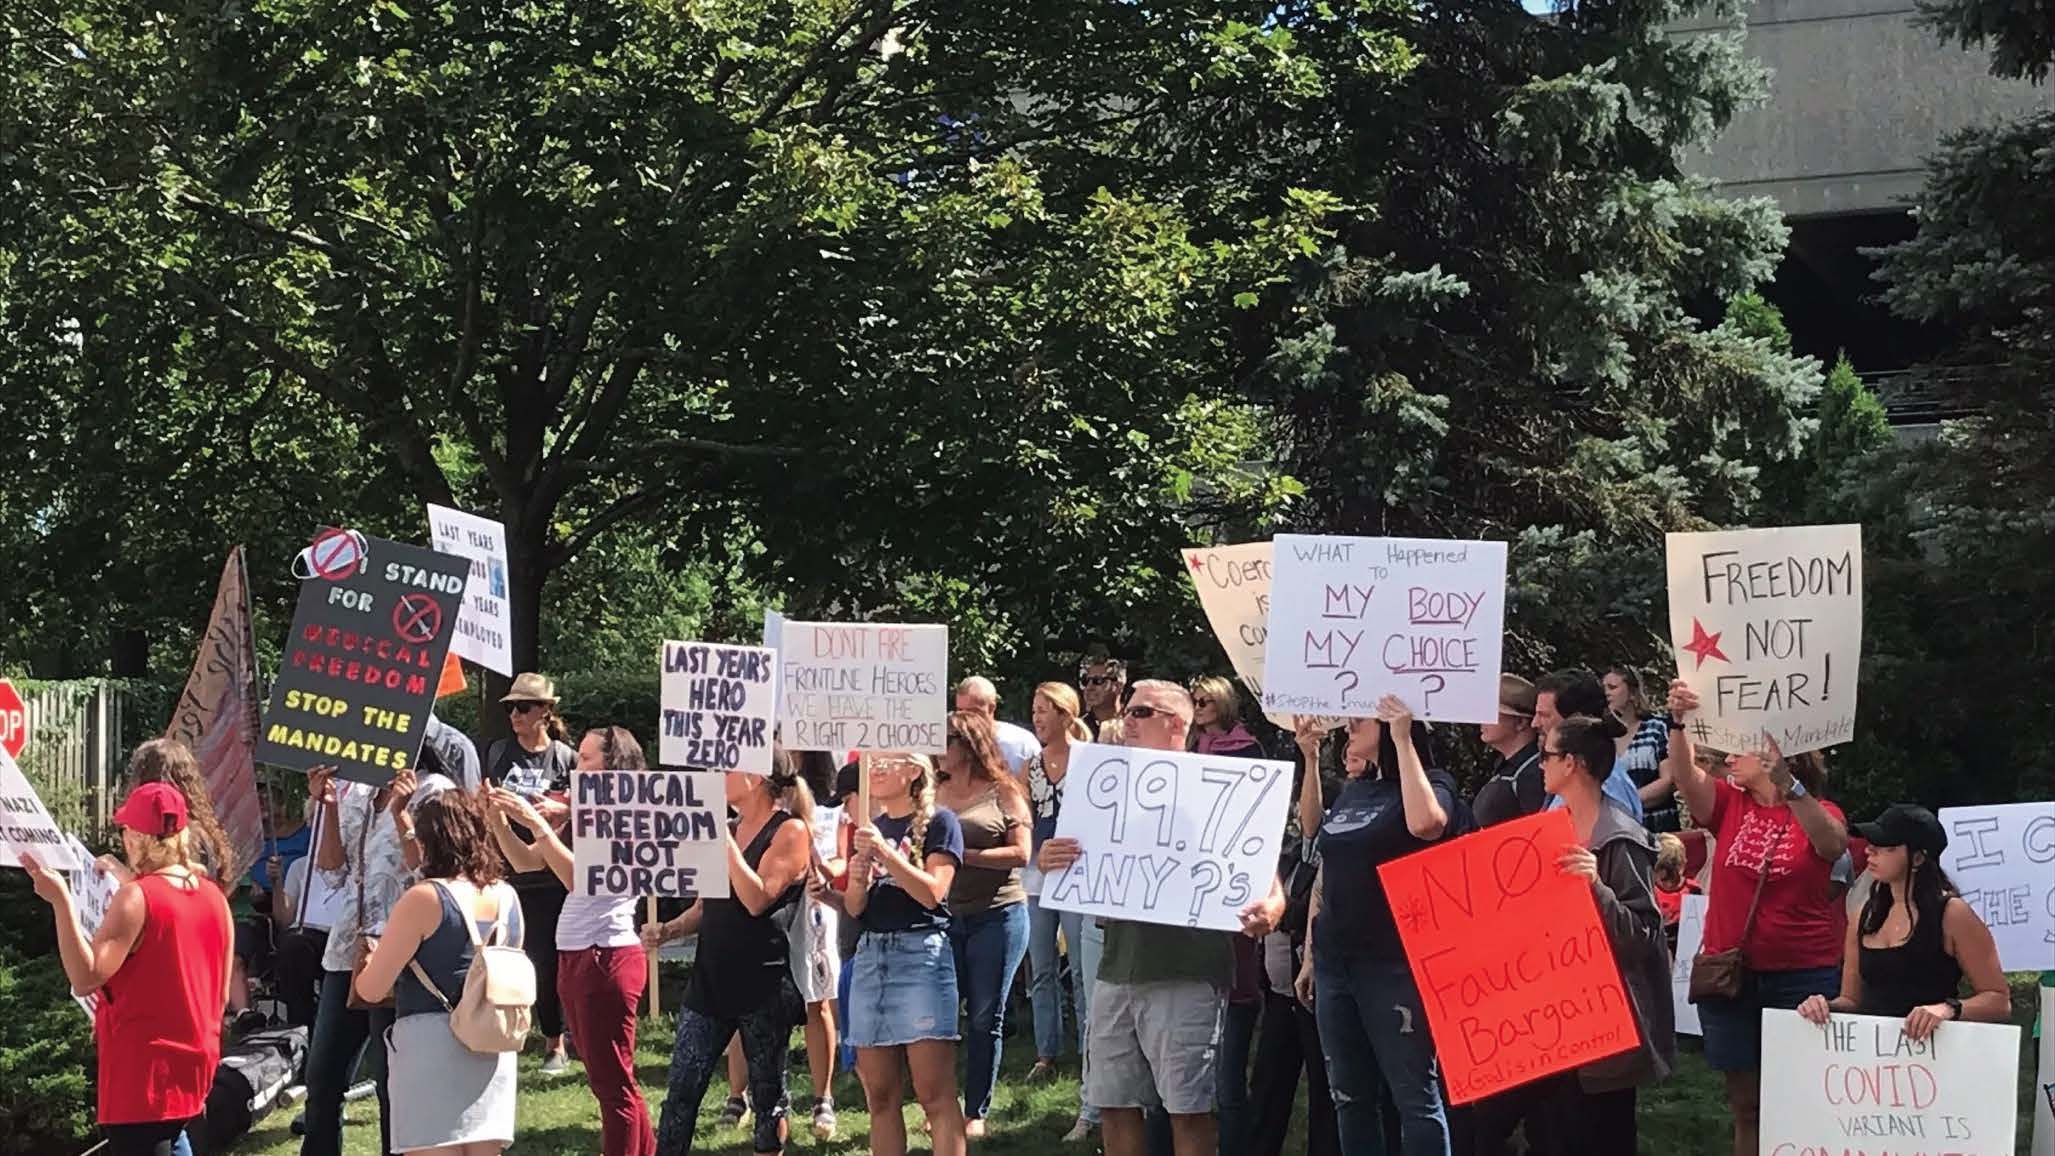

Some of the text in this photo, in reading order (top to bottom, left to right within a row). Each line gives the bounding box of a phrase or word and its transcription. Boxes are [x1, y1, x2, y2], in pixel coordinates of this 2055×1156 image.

[438, 521, 495, 551] LAST YEARS
[1293, 543, 1468, 568] WHAT Happened
[385, 561, 463, 595] STAND
[1369, 566, 1388, 580] TO
[1702, 551, 1852, 605] FREEDOM
[327, 586, 374, 613] FOR
[473, 594, 499, 618] YEARS
[1323, 583, 1486, 630] MY BODY
[303, 623, 431, 669] MEDICAL
[456, 617, 503, 650] EMPLOYED
[1304, 629, 1480, 671] MY CHOICE
[1745, 618, 1813, 661] NOT
[292, 650, 427, 695] FREEDOM
[664, 645, 711, 675] LAST
[688, 677, 747, 713] HERO
[872, 664, 937, 696] HEROES
[1333, 671, 1445, 717] ? ?
[284, 689, 412, 733] STOP THE
[786, 693, 817, 717] WE
[884, 696, 913, 720] THE
[663, 708, 767, 748] THIS YEAR
[795, 719, 943, 749] RIGHT 2 CHOOSE
[267, 724, 408, 770] MANDATES
[686, 739, 741, 768] ZERO
[0, 796, 40, 814] NAZI
[578, 772, 704, 807] MEDICAL
[1087, 757, 1282, 857] 99.7%
[8, 826, 61, 844] COMING
[576, 808, 718, 841] FREEDOM
[611, 840, 680, 868] NOT
[1953, 816, 2005, 872] I
[587, 865, 700, 897] FORCE
[1052, 850, 1181, 909] ANY
[1458, 983, 1625, 1066] Bargain
[1823, 1020, 1857, 1052] THE
[1824, 1063, 1937, 1110] COVID
[1838, 1113, 1972, 1139] VARIANT IS
